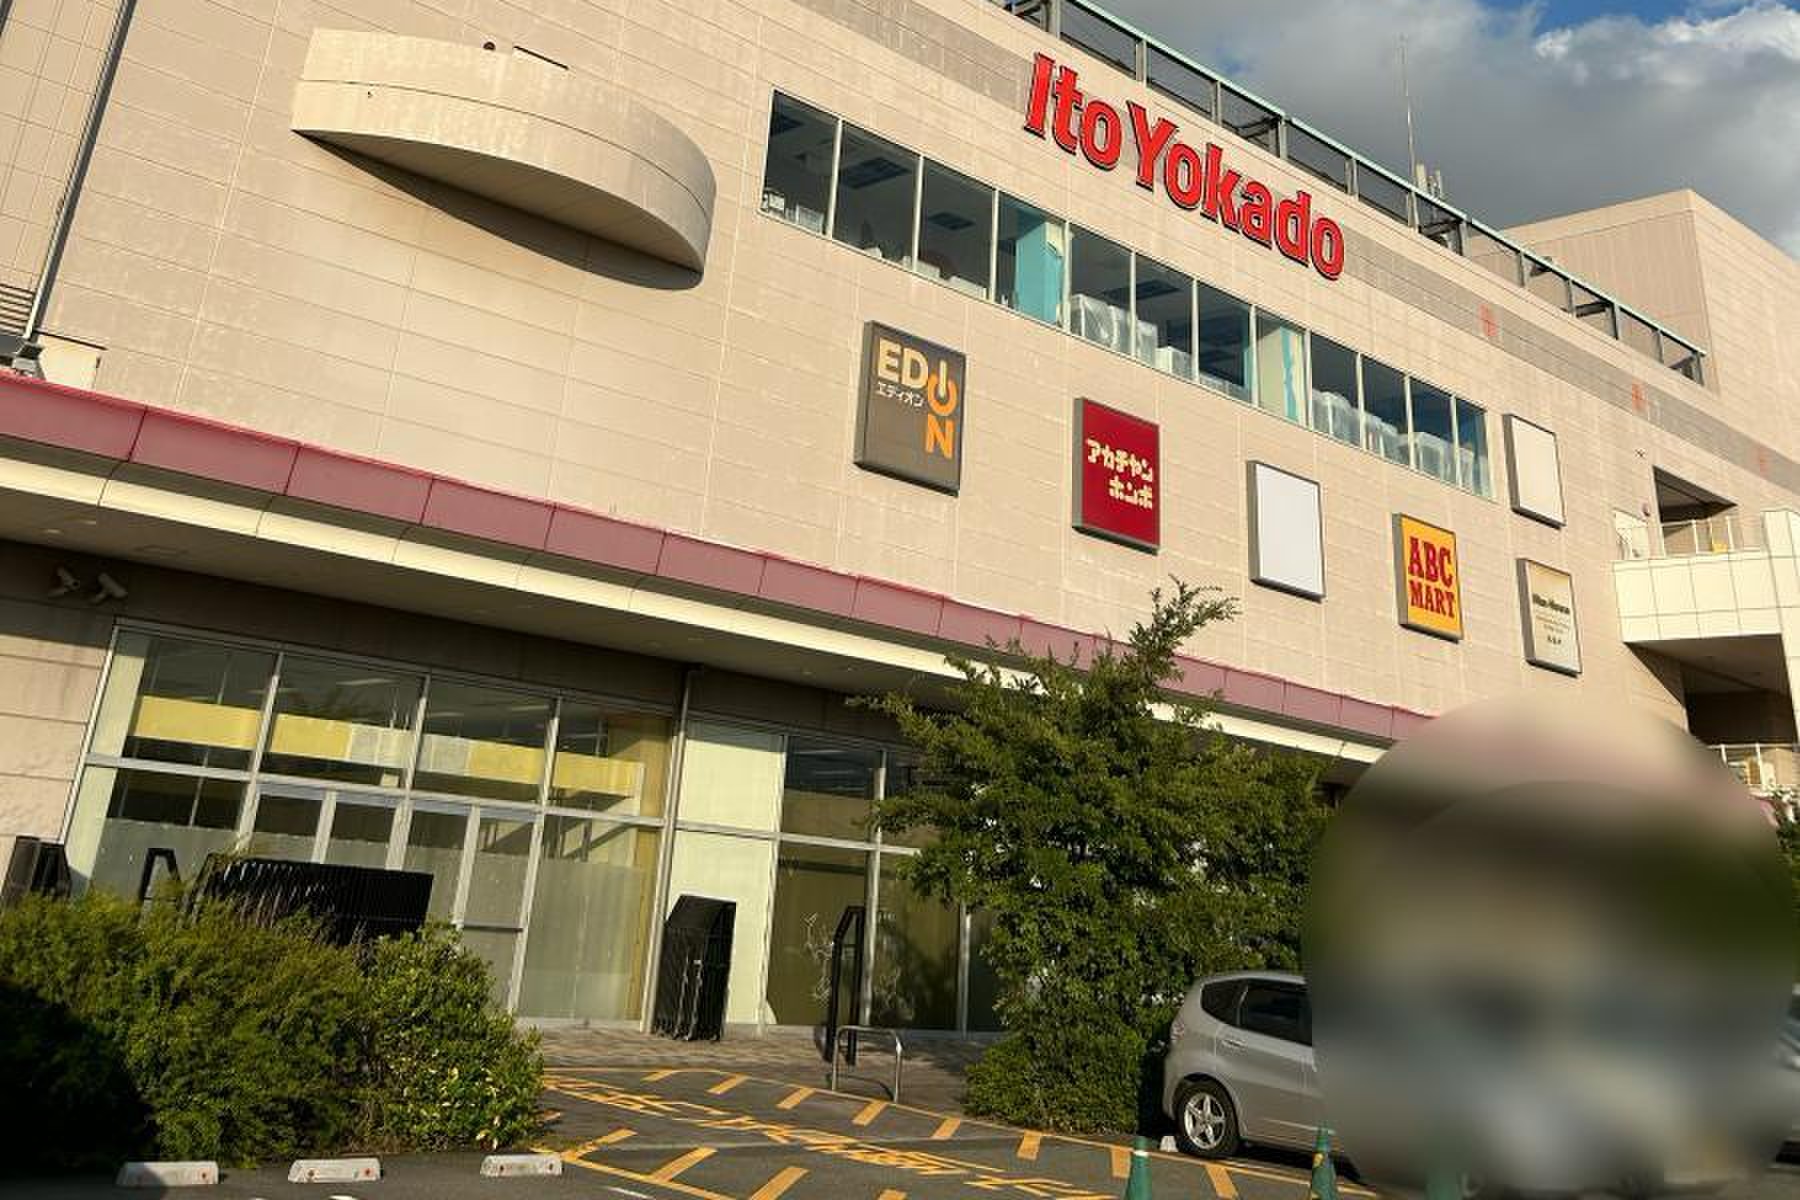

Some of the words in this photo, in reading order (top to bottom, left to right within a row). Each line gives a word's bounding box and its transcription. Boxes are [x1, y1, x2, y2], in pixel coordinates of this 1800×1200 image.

[1024, 52, 1123, 170] Ito
[1126, 100, 1346, 281] Yokado
[877, 381, 925, 408] エディオン
[1086, 436, 1153, 483] アカチャン
[1408, 536, 1454, 588] ABC
[1409, 579, 1456, 619] MART
